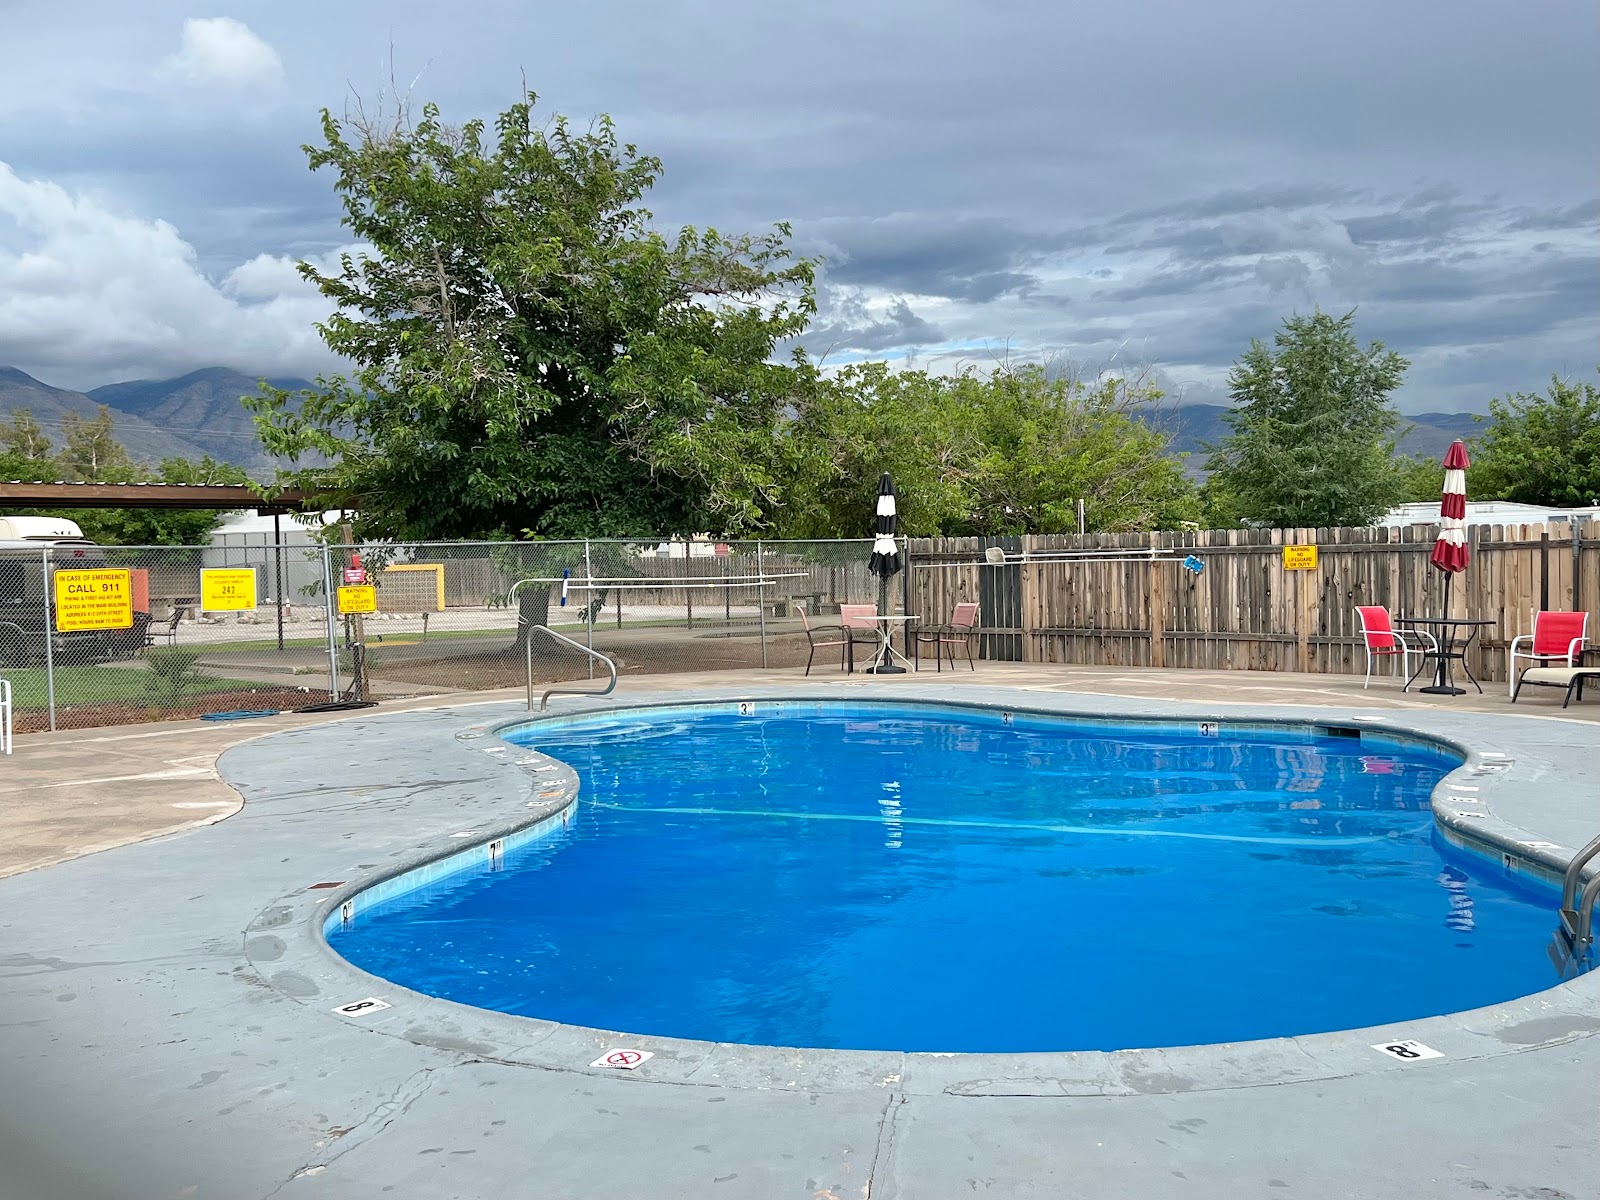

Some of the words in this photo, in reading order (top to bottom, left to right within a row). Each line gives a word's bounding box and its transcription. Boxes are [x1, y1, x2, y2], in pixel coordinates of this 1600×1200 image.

[68, 584, 96, 593] CALL
[102, 584, 120, 592] 911
[222, 586, 235, 594] 247
[1202, 724, 1208, 736] 3
[490, 843, 495, 859] 7
[342, 1002, 374, 1012] 8
[1386, 1045, 1420, 1058] 8
